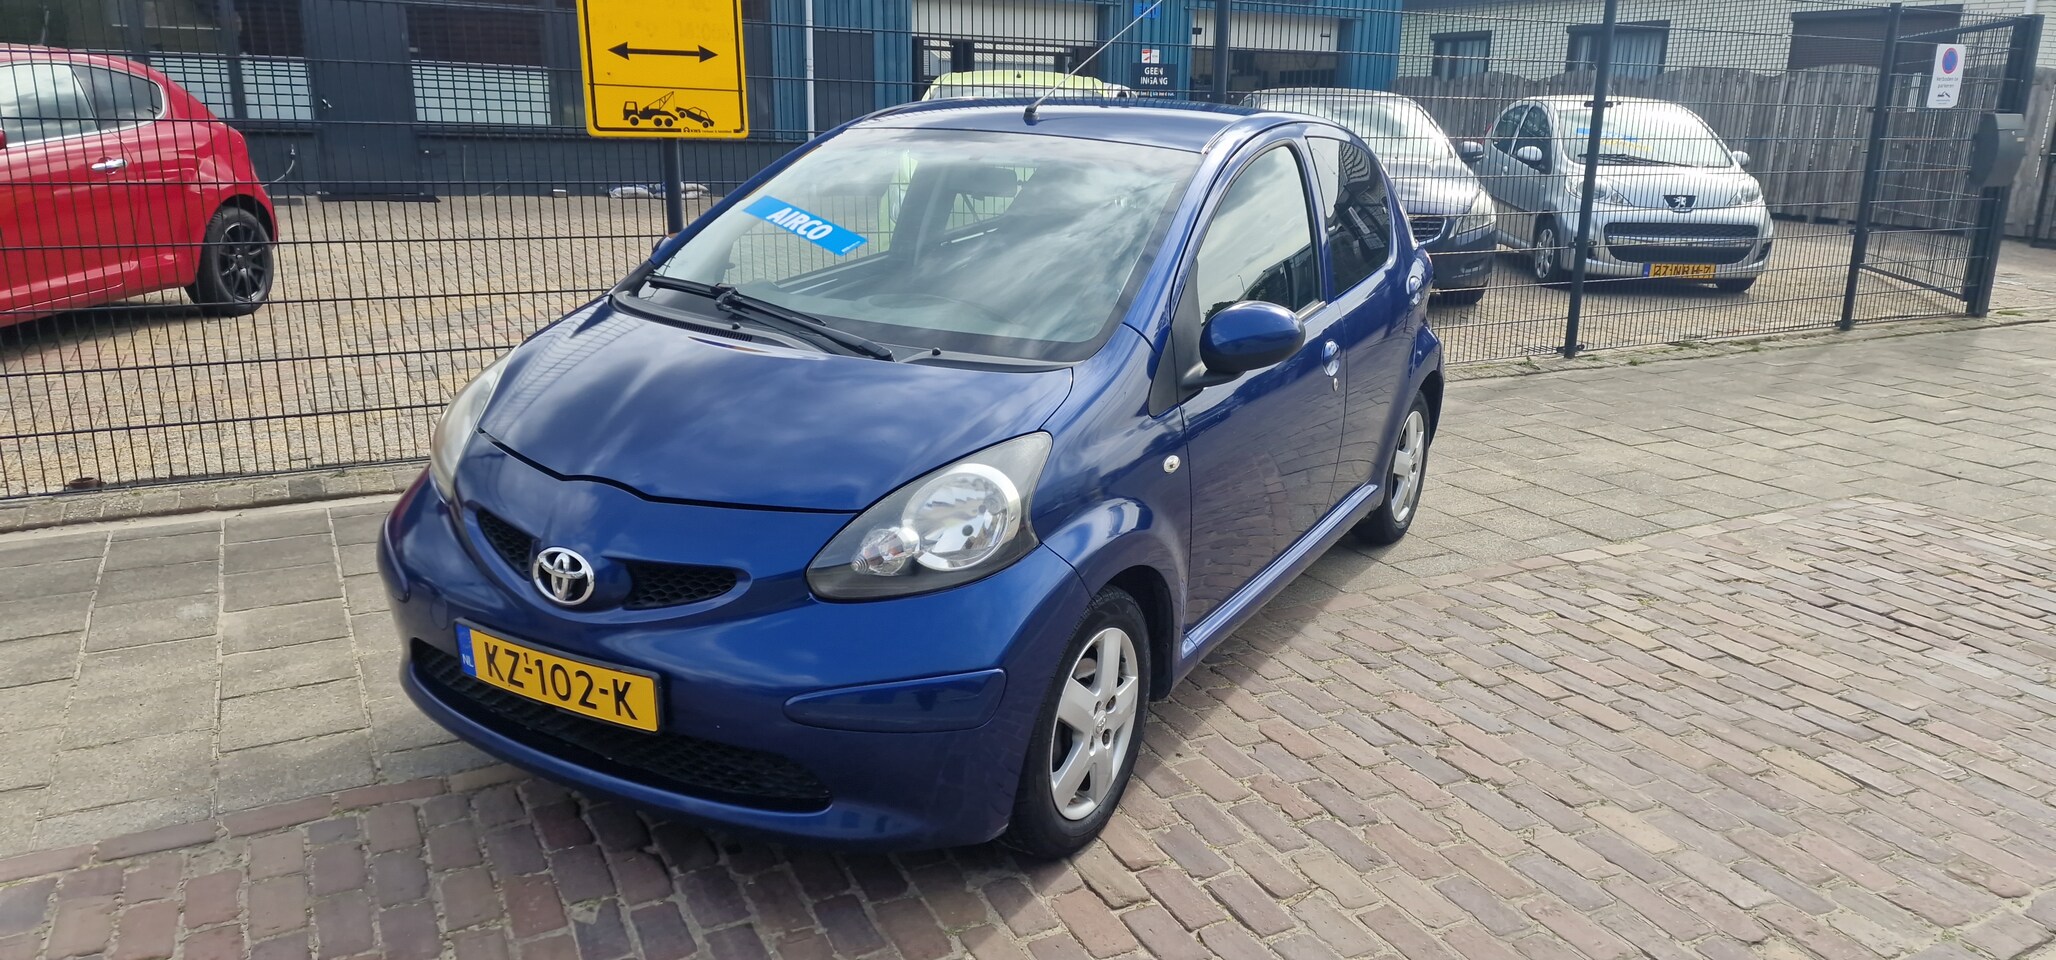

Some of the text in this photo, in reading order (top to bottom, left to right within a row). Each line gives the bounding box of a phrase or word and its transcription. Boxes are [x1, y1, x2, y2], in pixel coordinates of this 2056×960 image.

[1144, 67, 1164, 75] GEEN
[1140, 76, 1169, 85] INGANG
[765, 207, 834, 240] AIRCO
[462, 654, 474, 667] NL
[484, 641, 638, 720] KZ-102-K
